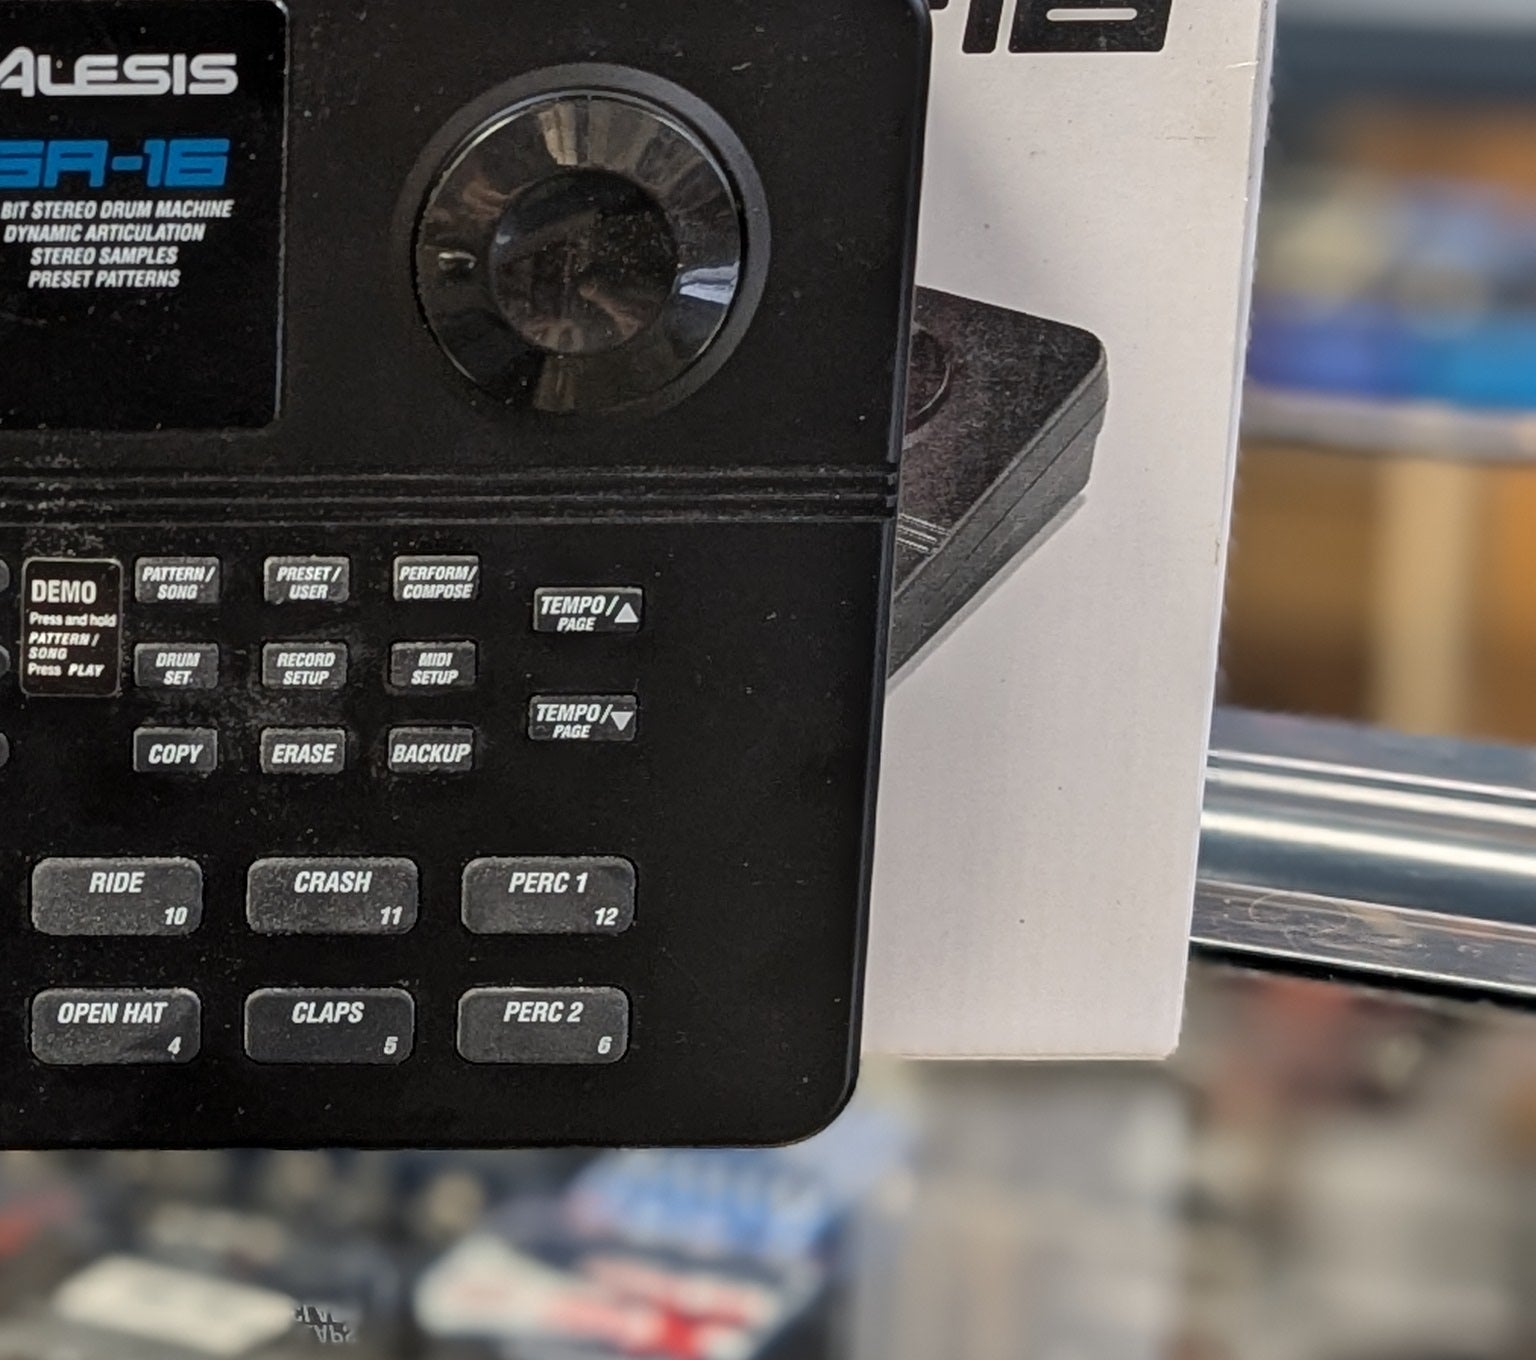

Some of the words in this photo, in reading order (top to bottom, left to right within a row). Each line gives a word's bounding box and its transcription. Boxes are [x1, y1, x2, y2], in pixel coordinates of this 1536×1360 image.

[1, 202, 29, 220] BIT
[31, 201, 96, 219] STEREO
[100, 201, 151, 218] DRUM
[155, 200, 234, 218] MACHINE
[4, 224, 82, 243] DYNAMIC
[85, 224, 205, 242] ARTICULATION
[31, 247, 95, 265] STEREO
[99, 247, 178, 264] SAMPLES
[28, 270, 93, 288] PRESET
[96, 270, 180, 288] PATTERNS
[277, 566, 341, 582] PRESET/
[400, 565, 476, 583] PERFORM/
[31, 580, 96, 604] DEMO
[157, 584, 197, 600] SONG
[289, 583, 328, 600] USER
[402, 583, 473, 600] COMPOSE
[29, 612, 63, 625] Press
[65, 613, 87, 626] and
[89, 614, 116, 627] hold
[557, 617, 595, 632] PAGE
[28, 647, 67, 660] SONG
[156, 653, 200, 667] DRUM
[277, 651, 335, 668] RECORD
[419, 651, 452, 668] MIDI
[28, 663, 62, 676] Press
[68, 664, 104, 677] PLAY
[164, 671, 191, 684] SET
[284, 669, 329, 685] SETUP
[411, 668, 458, 685] SETUP
[553, 724, 591, 739] PAGE
[148, 745, 202, 765] COPY
[271, 744, 337, 764] ERASE
[392, 744, 471, 764] BACKUP
[89, 872, 145, 893] RIDE
[294, 872, 372, 893] CRASH
[509, 872, 571, 893] PERC
[575, 872, 587, 893] 1
[164, 907, 187, 926] 10
[380, 907, 402, 926] 11
[594, 907, 618, 926] 12
[58, 1002, 118, 1024] OPEN
[123, 1002, 168, 1024] HAT
[293, 1002, 363, 1024] CLAPS
[504, 1002, 564, 1024] PERC
[568, 1002, 584, 1024] 2
[168, 1036, 181, 1055] 4
[385, 1036, 397, 1054] 5
[598, 1036, 611, 1054] 6
